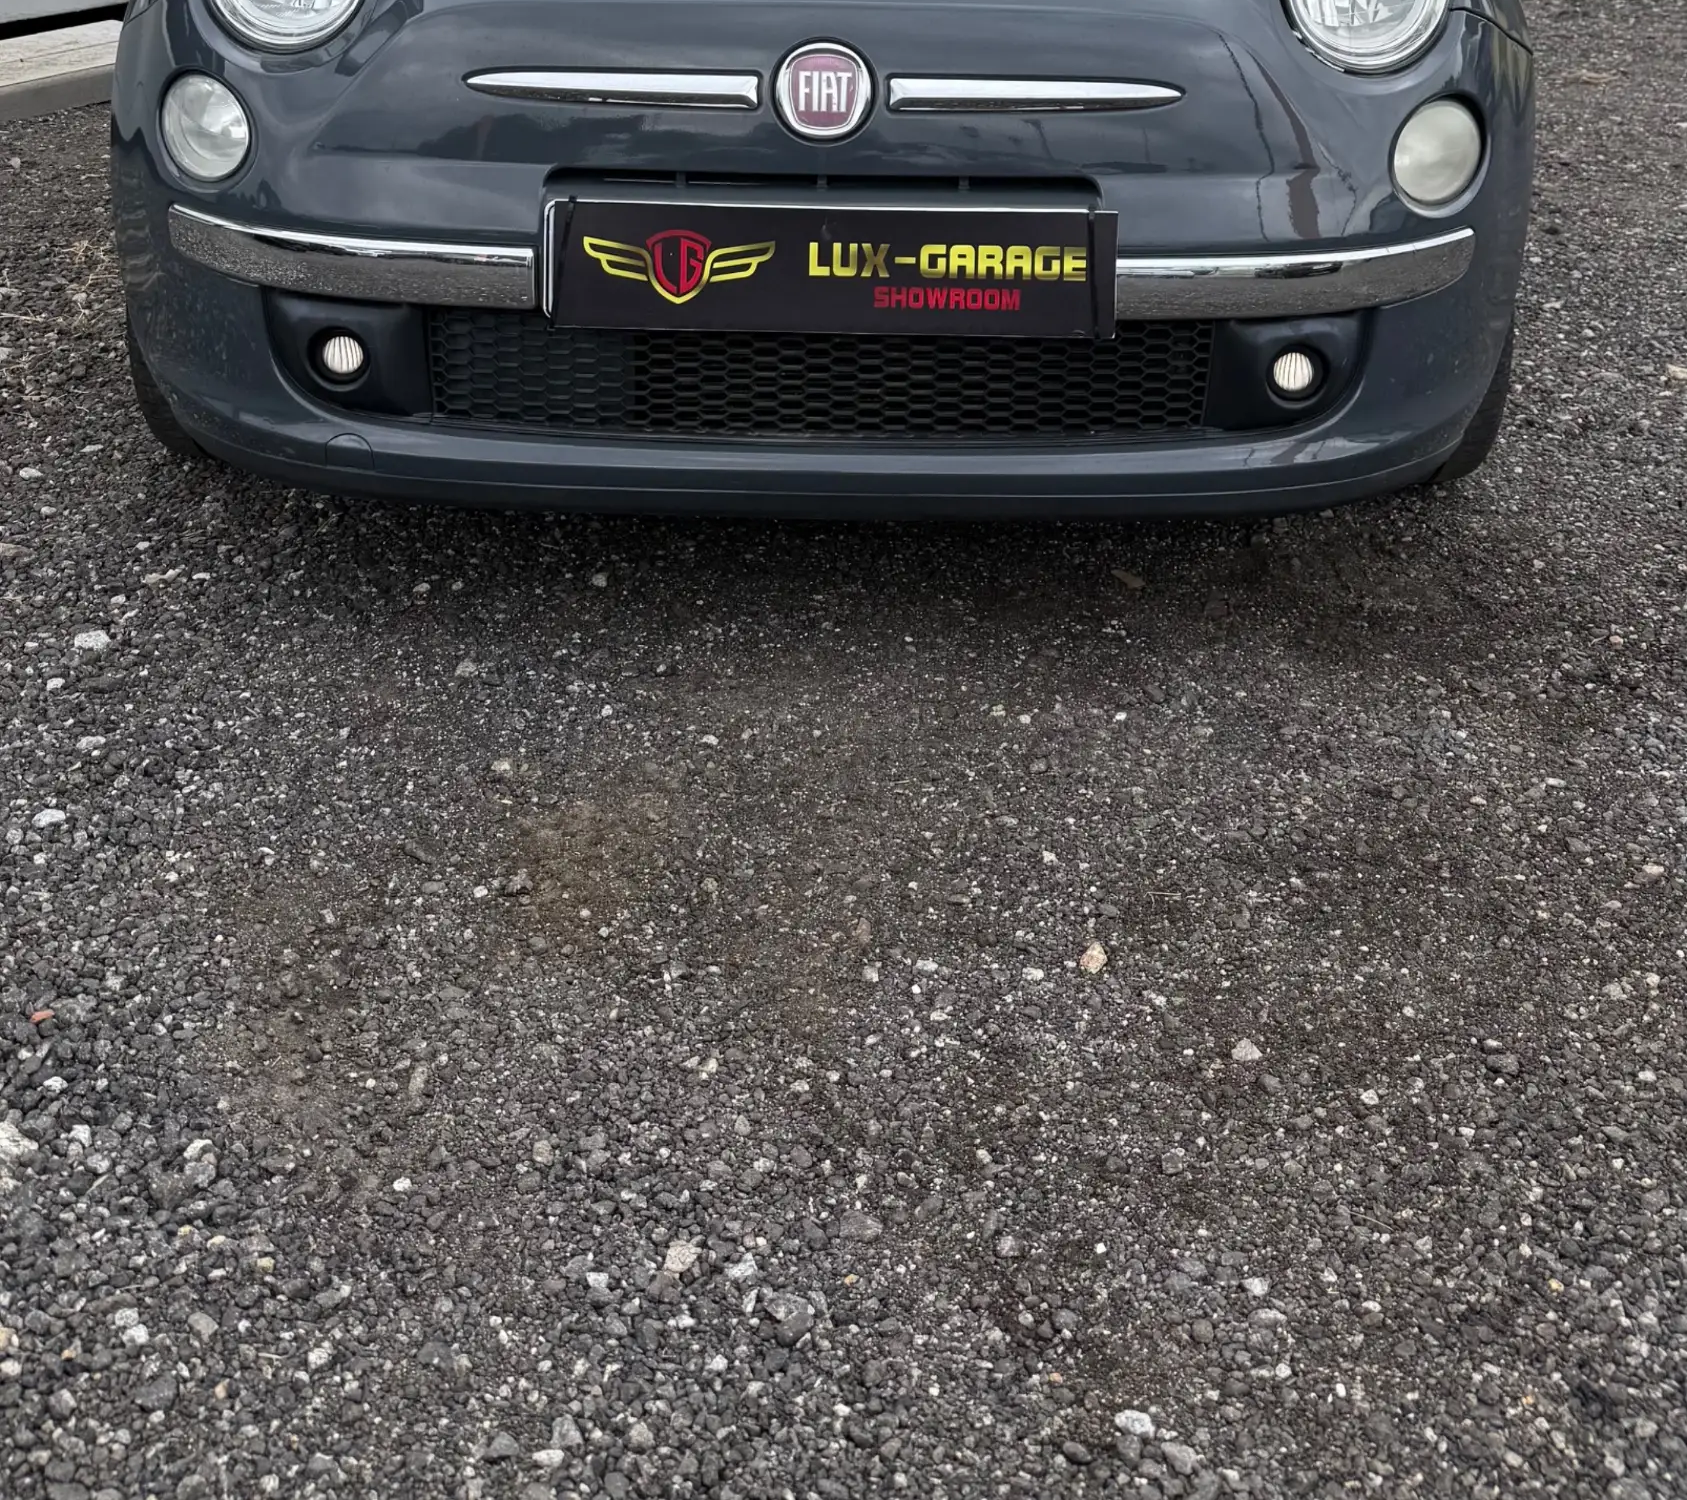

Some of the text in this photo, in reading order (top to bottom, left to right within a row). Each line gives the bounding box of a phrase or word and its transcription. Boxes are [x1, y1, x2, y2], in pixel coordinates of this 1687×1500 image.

[798, 70, 853, 113] FIAT
[807, 240, 1088, 283] LUX-GARAGE
[872, 285, 1022, 312] SHOWROOM
